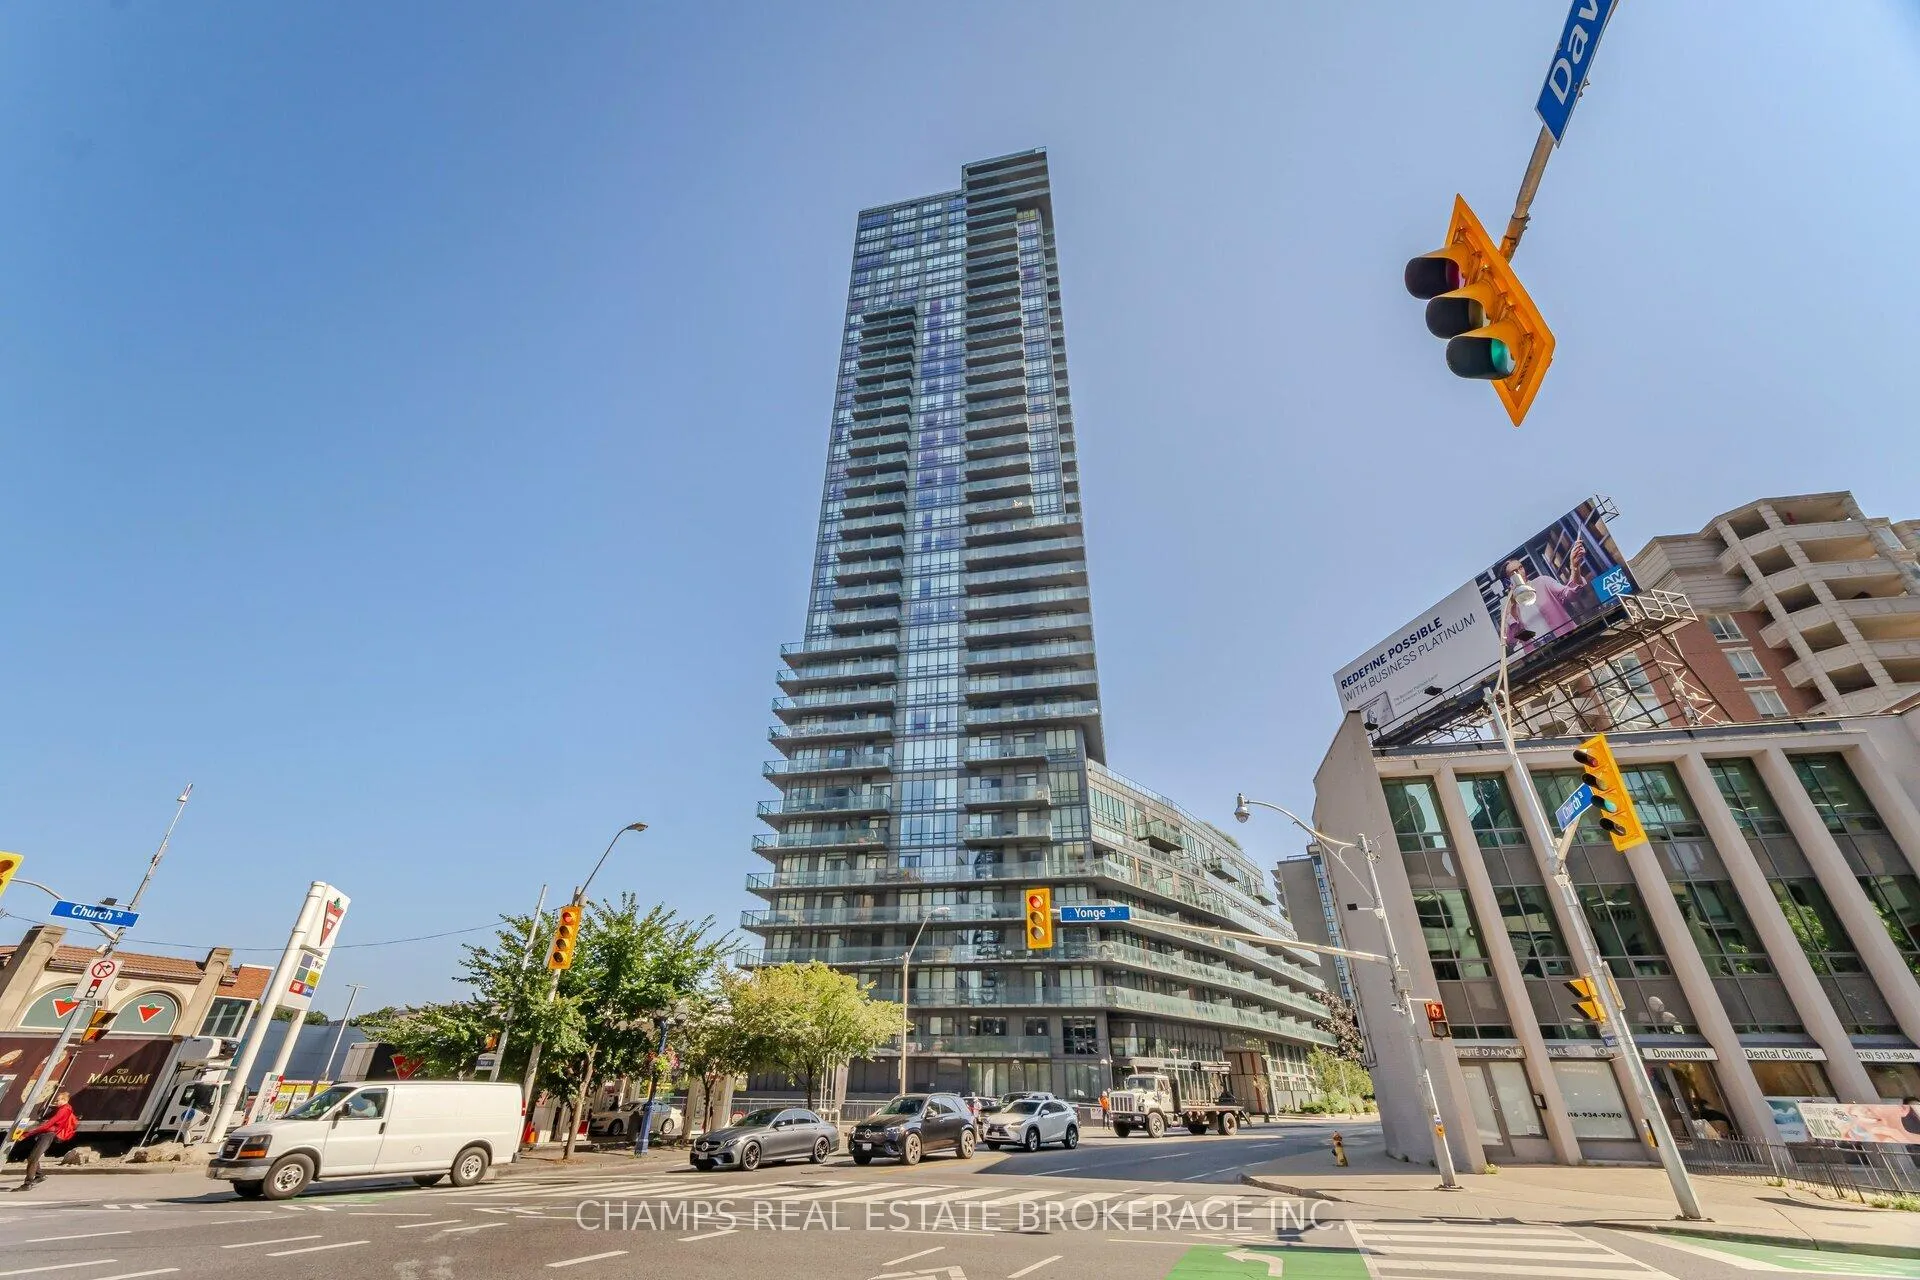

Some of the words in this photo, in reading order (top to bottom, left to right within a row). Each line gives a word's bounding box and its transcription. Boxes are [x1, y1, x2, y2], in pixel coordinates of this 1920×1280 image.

[1340, 653, 1387, 690] REDEFINE
[1388, 617, 1443, 659] POSSIBLE
[1344, 682, 1369, 702] WITH
[1368, 650, 1417, 688] BUSINESS
[1417, 612, 1476, 657] PLATINUM
[71, 904, 113, 921] Church
[1074, 907, 1106, 920] Yonge
[1482, 1048, 1524, 1057] D'AMOUR
[1652, 1048, 1708, 1059] Downtown
[1746, 1048, 1780, 1059] Dental
[1783, 1048, 1814, 1060] Clinic
[1875, 1051, 1915, 1060] 513-9494
[86, 1073, 150, 1085] MAGNUM
